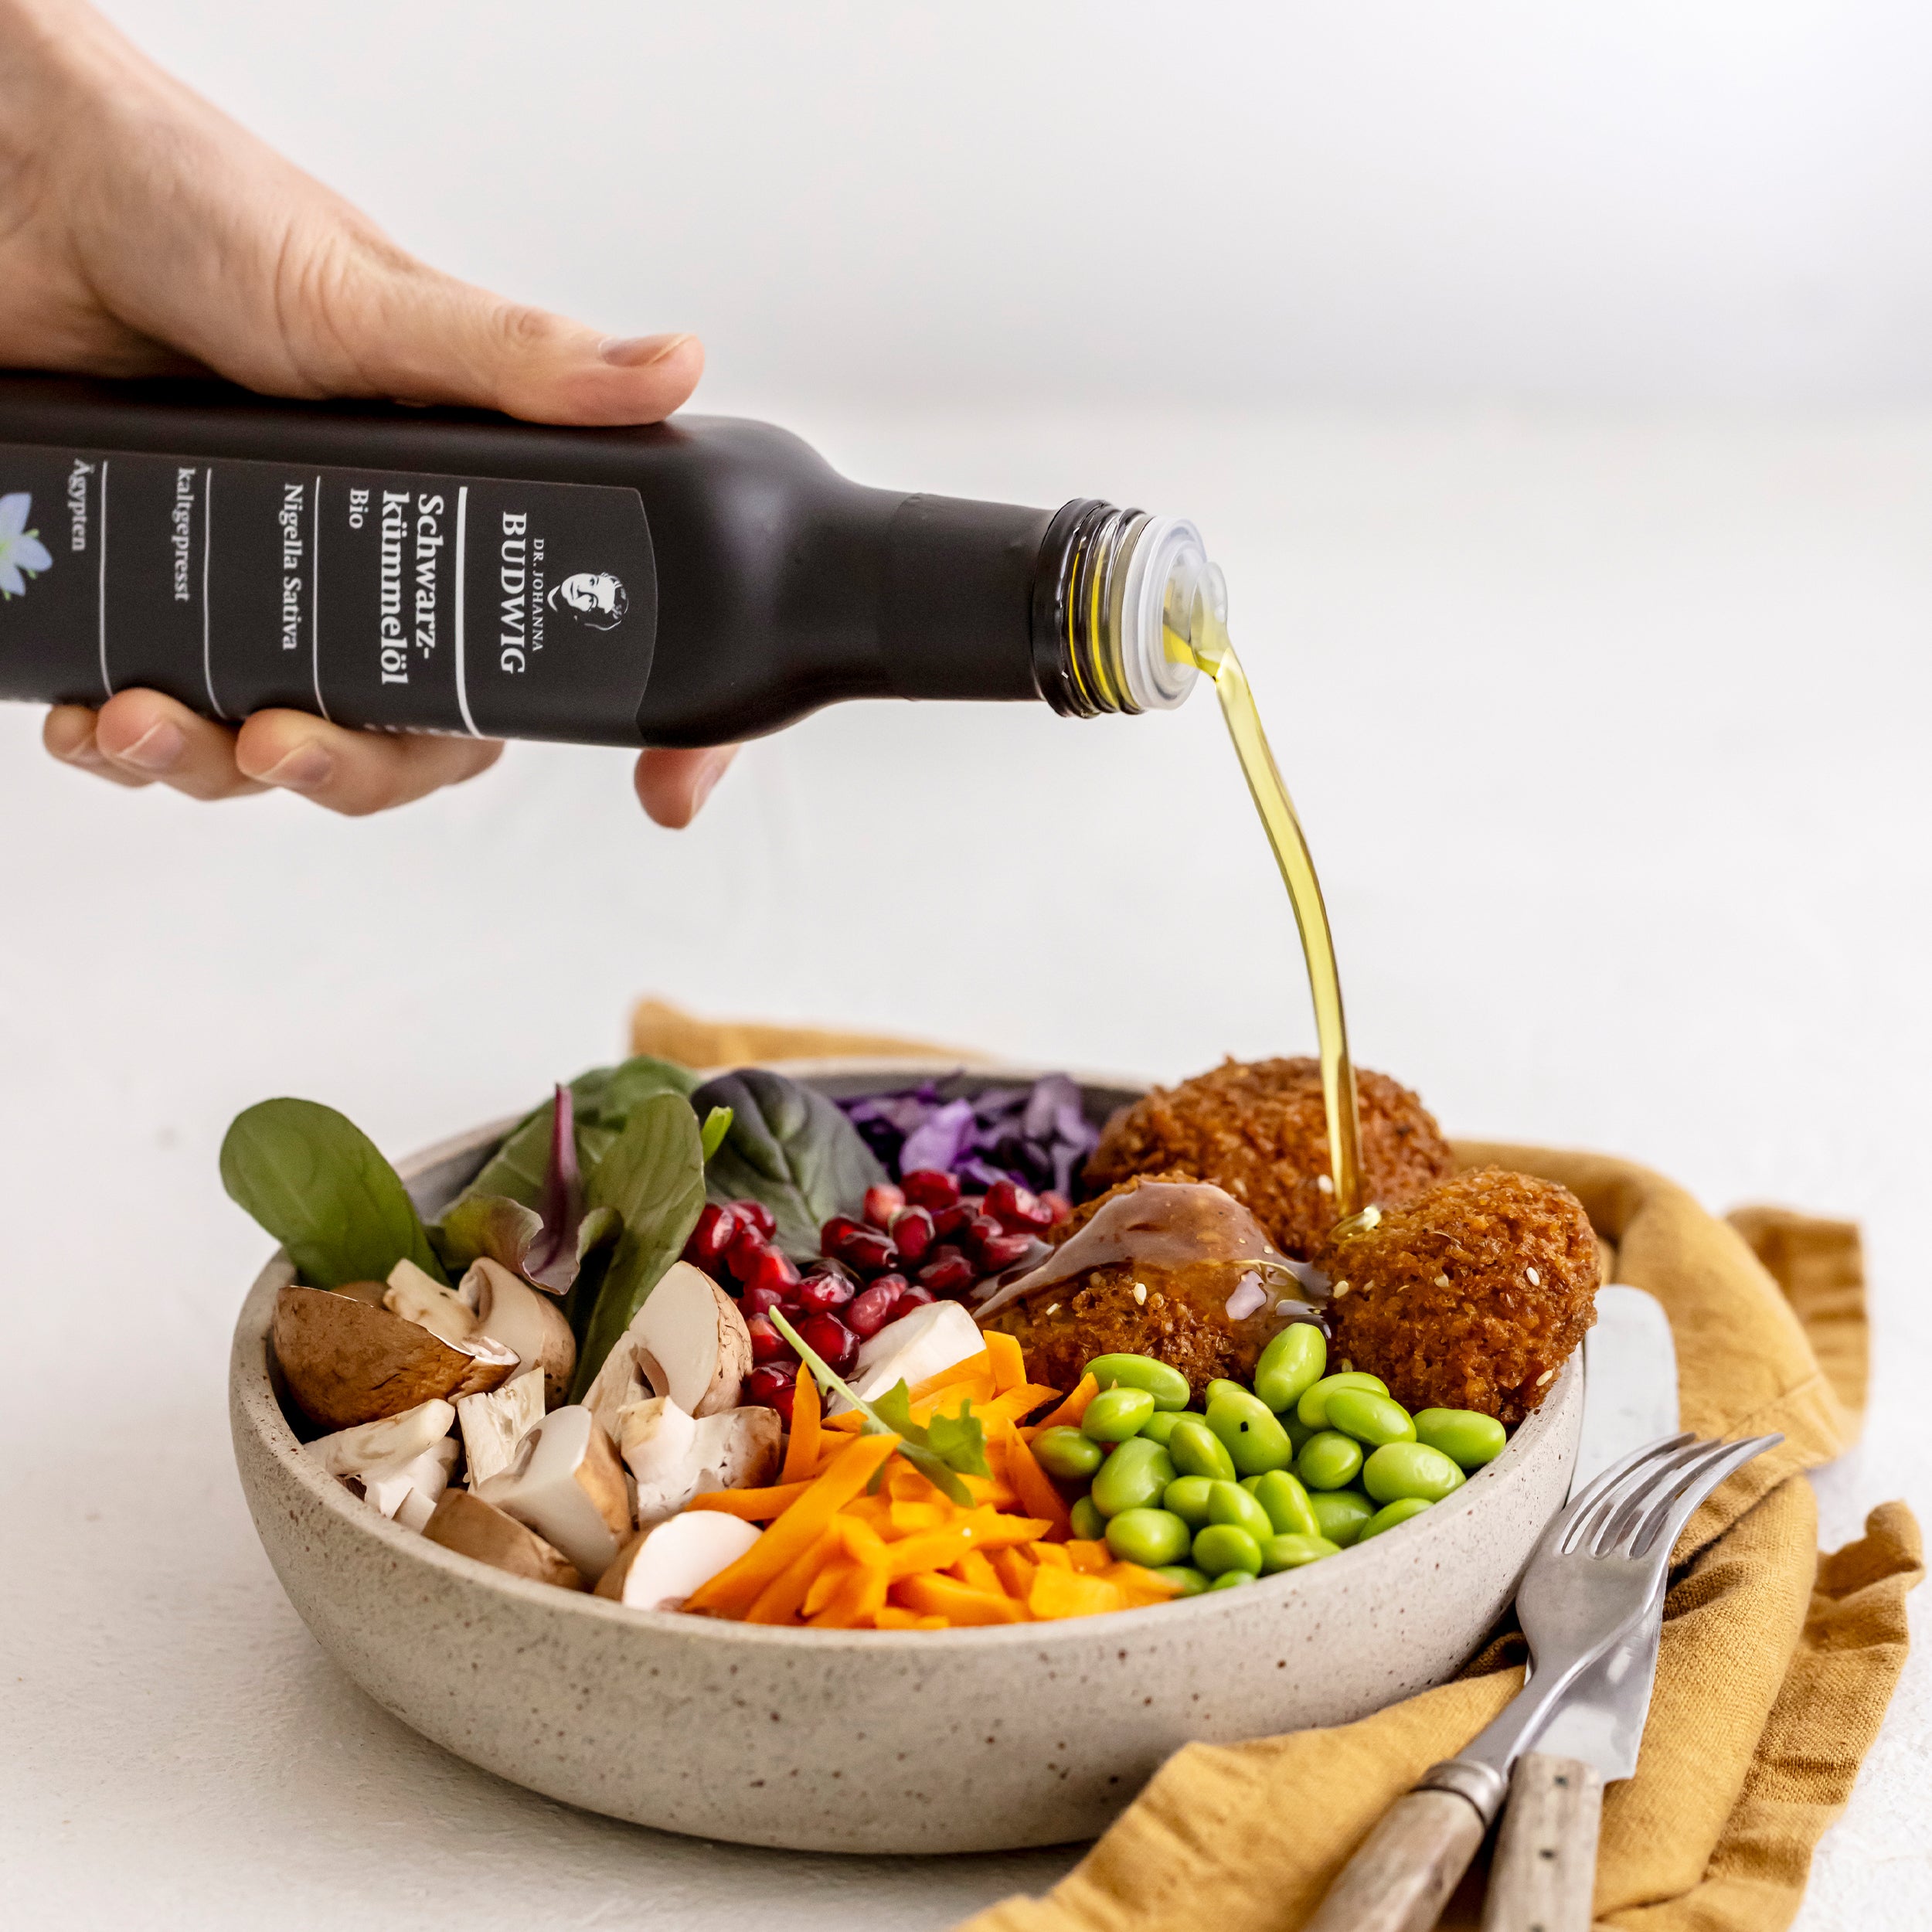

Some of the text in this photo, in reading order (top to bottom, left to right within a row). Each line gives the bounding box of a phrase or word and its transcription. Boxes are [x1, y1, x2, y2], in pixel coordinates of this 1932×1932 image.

[67, 458, 95, 550] Ägypten
[171, 467, 196, 601] kaltgepresst
[279, 483, 304, 650] Nigella Sativa
[349, 488, 369, 529] Bio
[415, 493, 444, 659] Schwarz-
[380, 489, 410, 685] kümmelöl
[500, 511, 527, 675] BUDWIG
[532, 538, 545, 651] DR. JOHANNA
